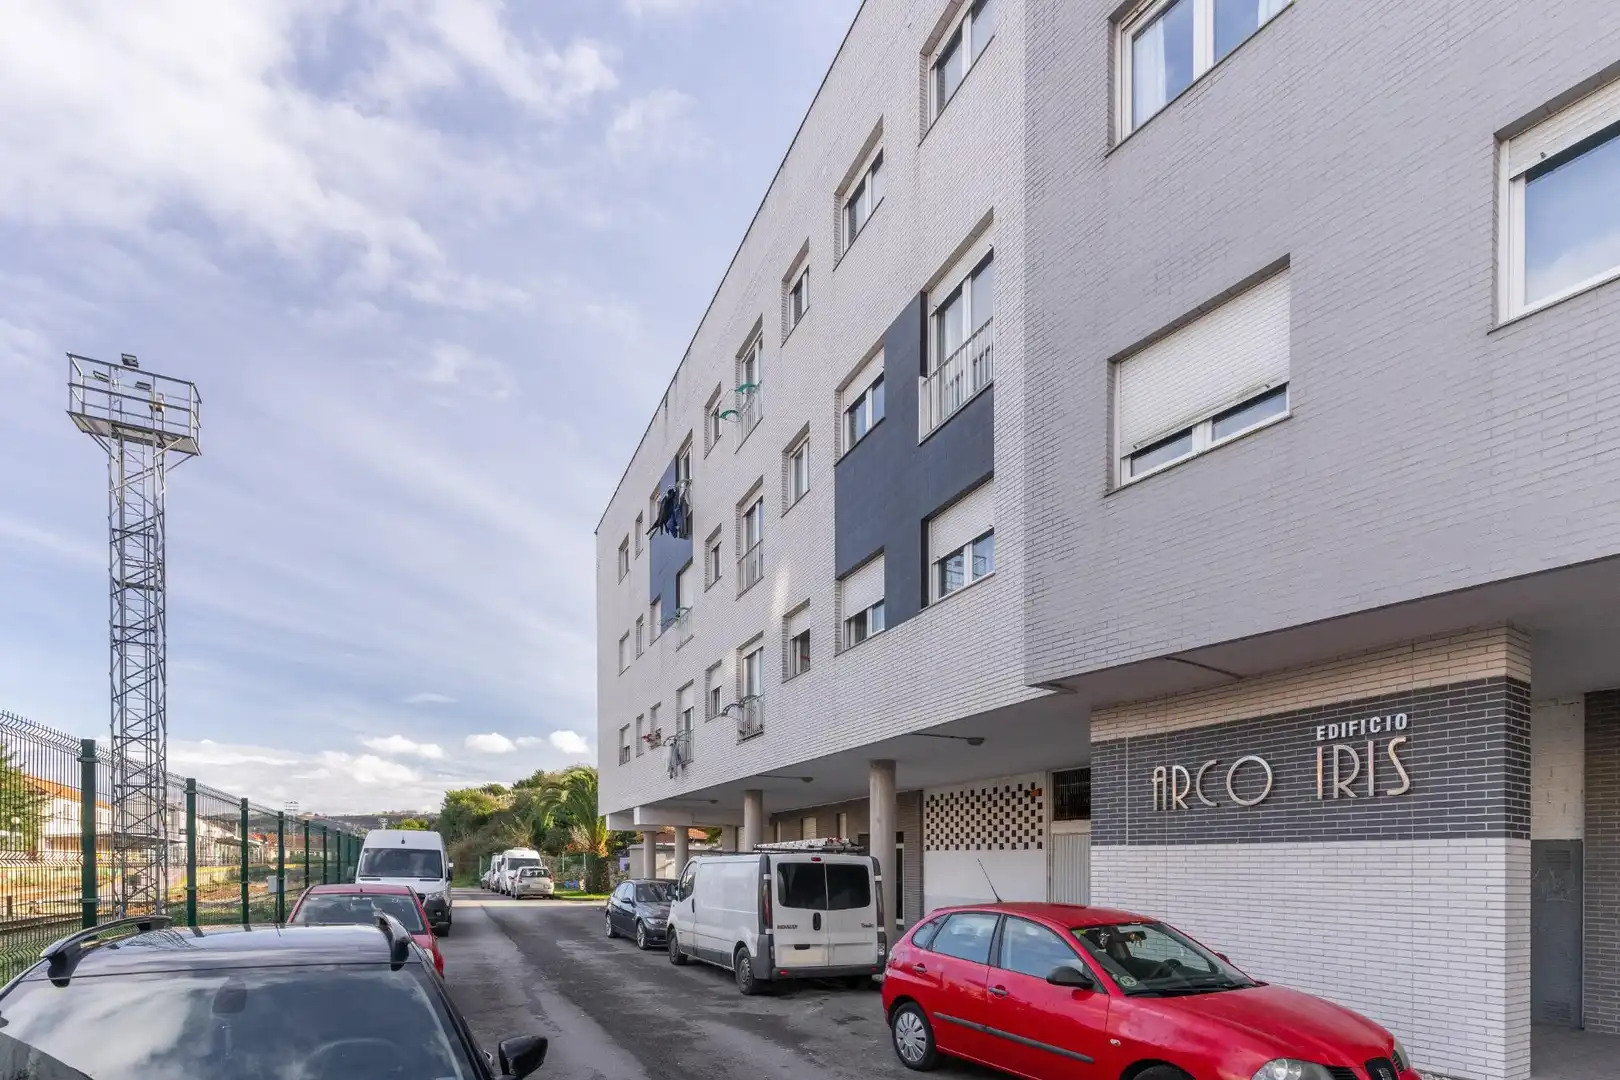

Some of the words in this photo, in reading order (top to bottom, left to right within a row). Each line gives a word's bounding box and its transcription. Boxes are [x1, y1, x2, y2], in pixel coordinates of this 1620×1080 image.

[1316, 713, 1408, 741] EDIFICIO
[1151, 755, 1273, 811] ARCO
[1316, 736, 1410, 800] IRIS
